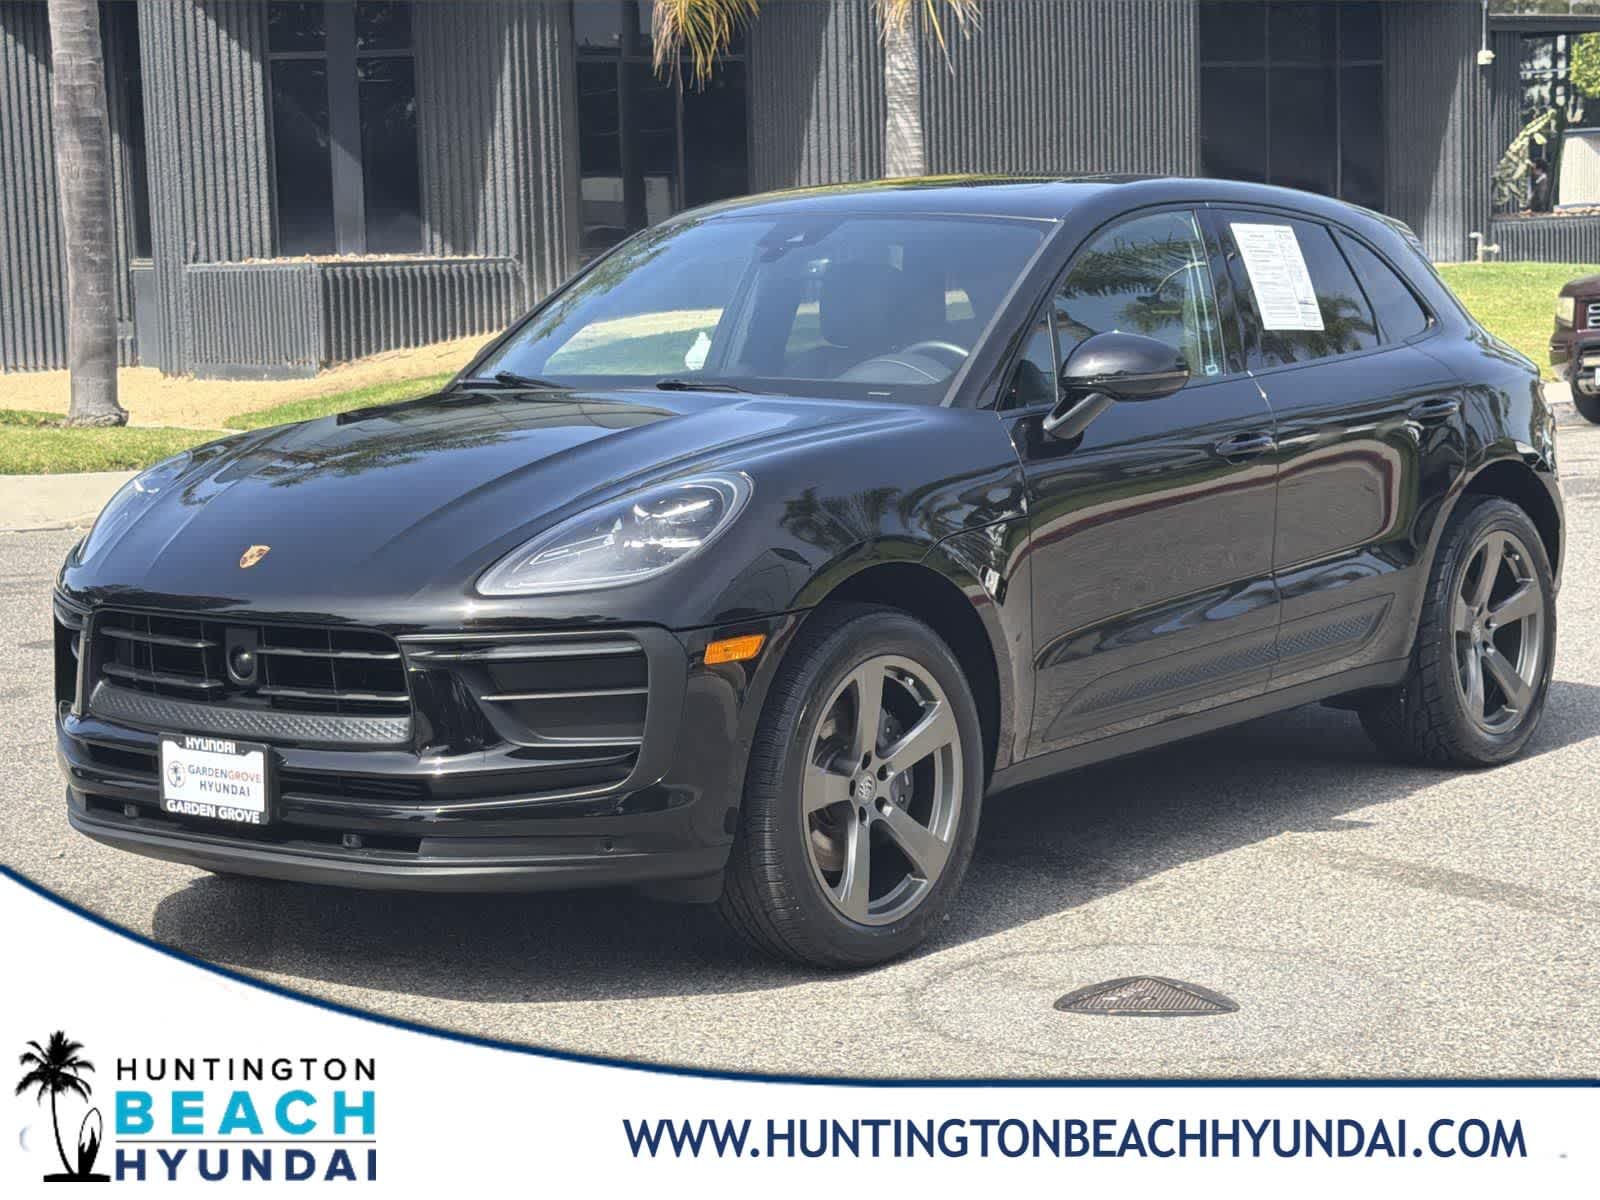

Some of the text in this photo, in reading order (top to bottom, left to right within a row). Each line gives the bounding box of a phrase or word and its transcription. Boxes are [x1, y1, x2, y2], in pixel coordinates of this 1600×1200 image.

[185, 736, 236, 754] HYUNDAI
[200, 780, 251, 797] HYUNDAI
[166, 799, 260, 824] GARDEN GROVE
